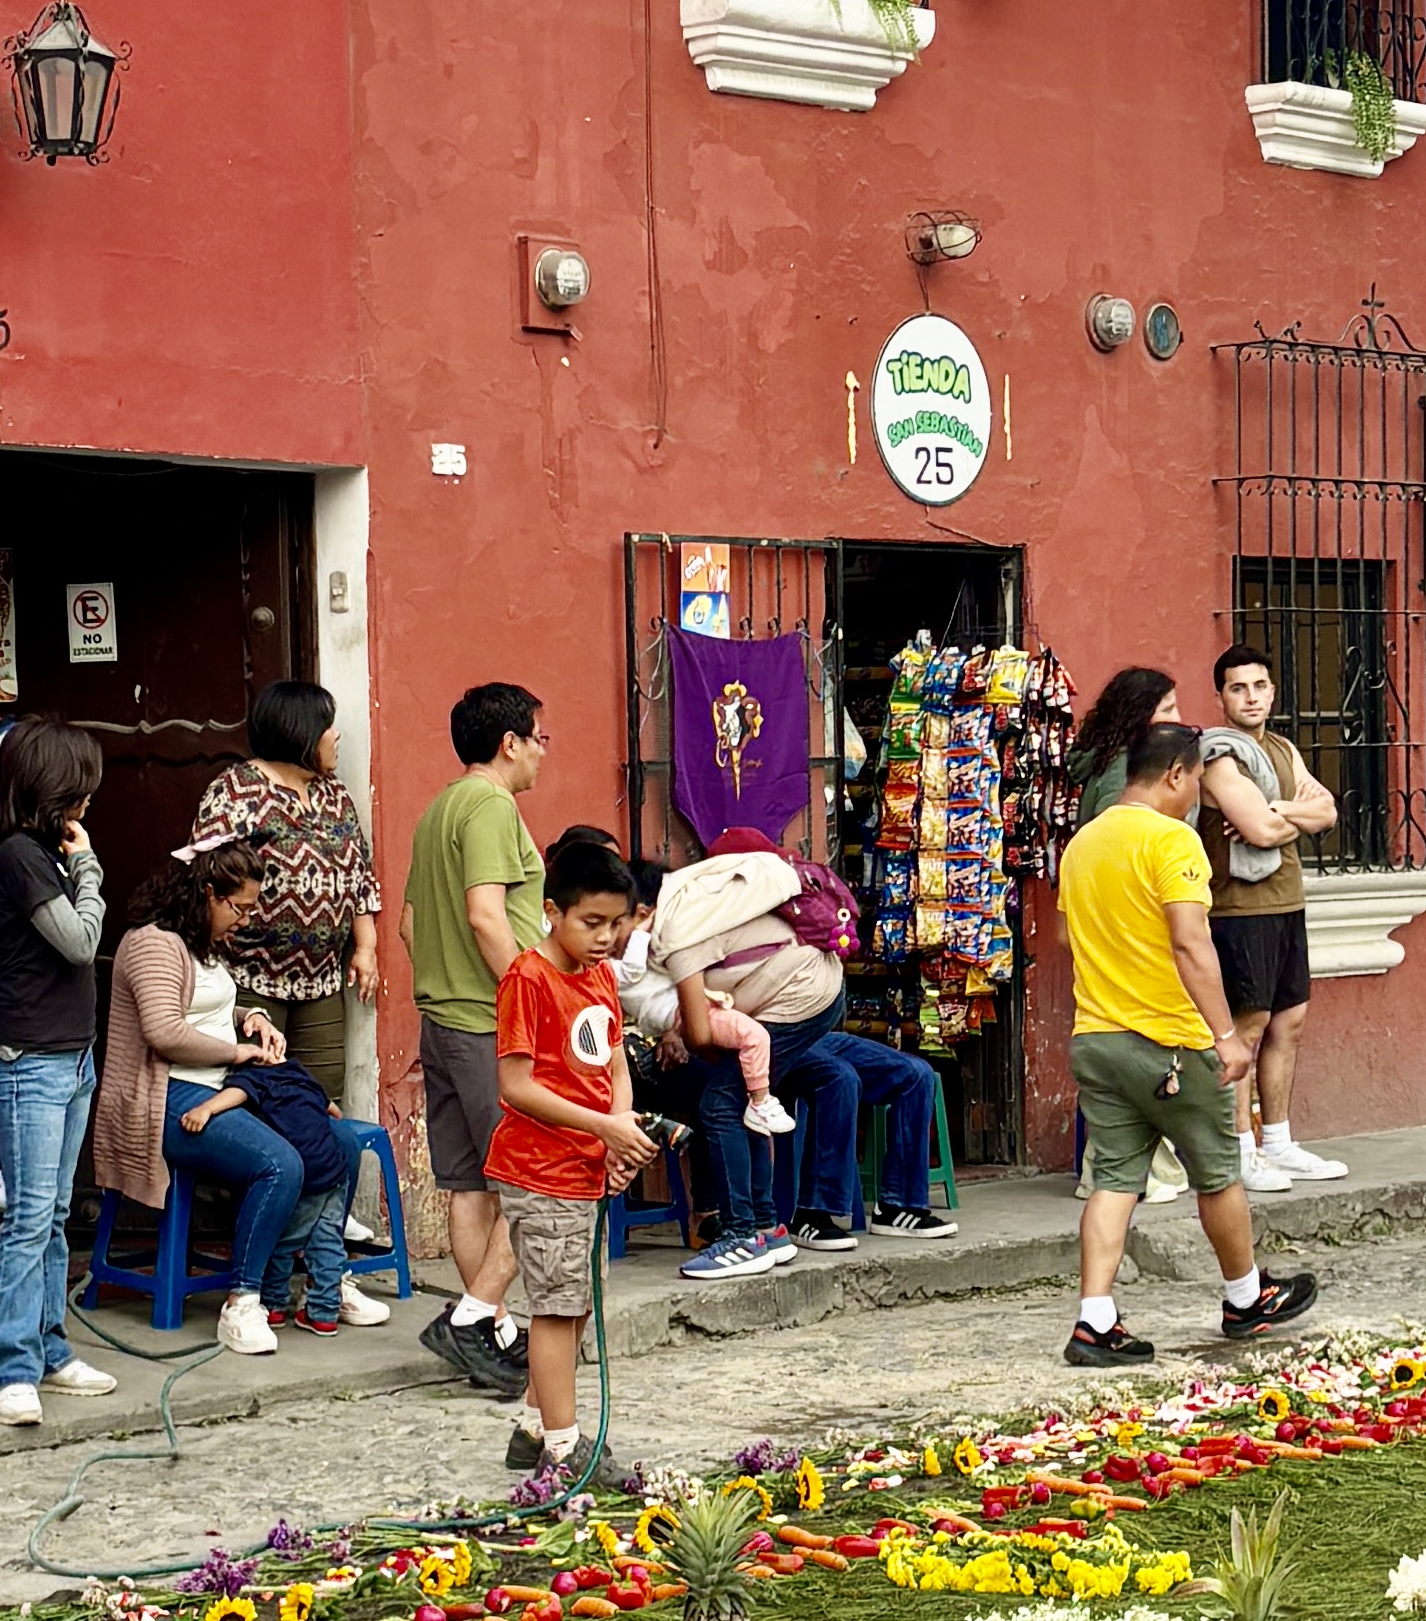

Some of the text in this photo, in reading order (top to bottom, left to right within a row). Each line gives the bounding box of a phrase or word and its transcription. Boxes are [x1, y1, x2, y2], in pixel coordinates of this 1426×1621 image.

[887, 418, 915, 448] SAN
[915, 447, 954, 485] 25
[82, 633, 102, 644] NO
